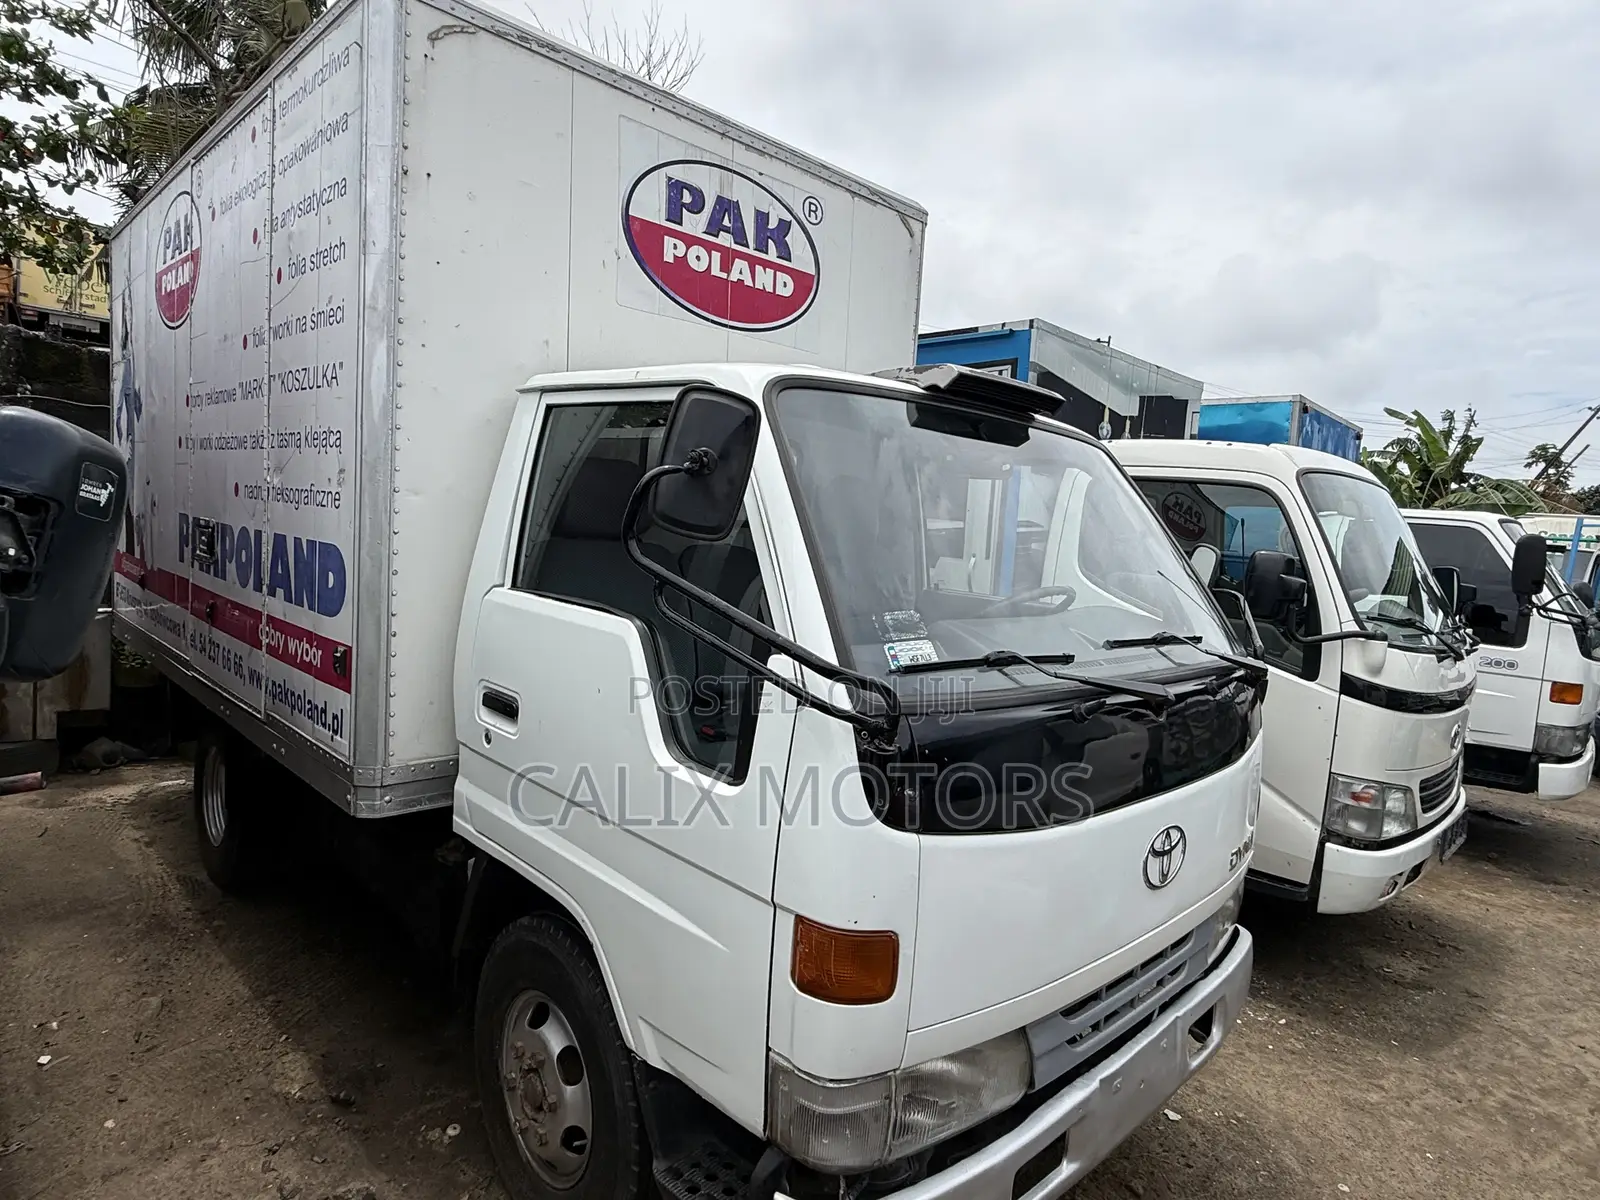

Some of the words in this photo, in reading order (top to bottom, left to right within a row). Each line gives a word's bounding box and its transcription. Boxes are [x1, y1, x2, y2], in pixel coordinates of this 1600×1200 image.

[280, 176, 348, 229] antystatyczna
[663, 173, 793, 263] PAK
[288, 252, 307, 281] folia
[309, 235, 347, 275] stretch
[663, 234, 795, 298] POLAND
[272, 313, 293, 342] worki
[296, 315, 307, 335] na
[310, 298, 345, 331] śmieci
[205, 386, 237, 408] reklamowe
[278, 361, 345, 395] "KOSZULKA"
[277, 426, 302, 455] taśmą
[304, 424, 342, 455] klejącą
[287, 635, 322, 668] wybór
[1479, 656, 1519, 671] 200
